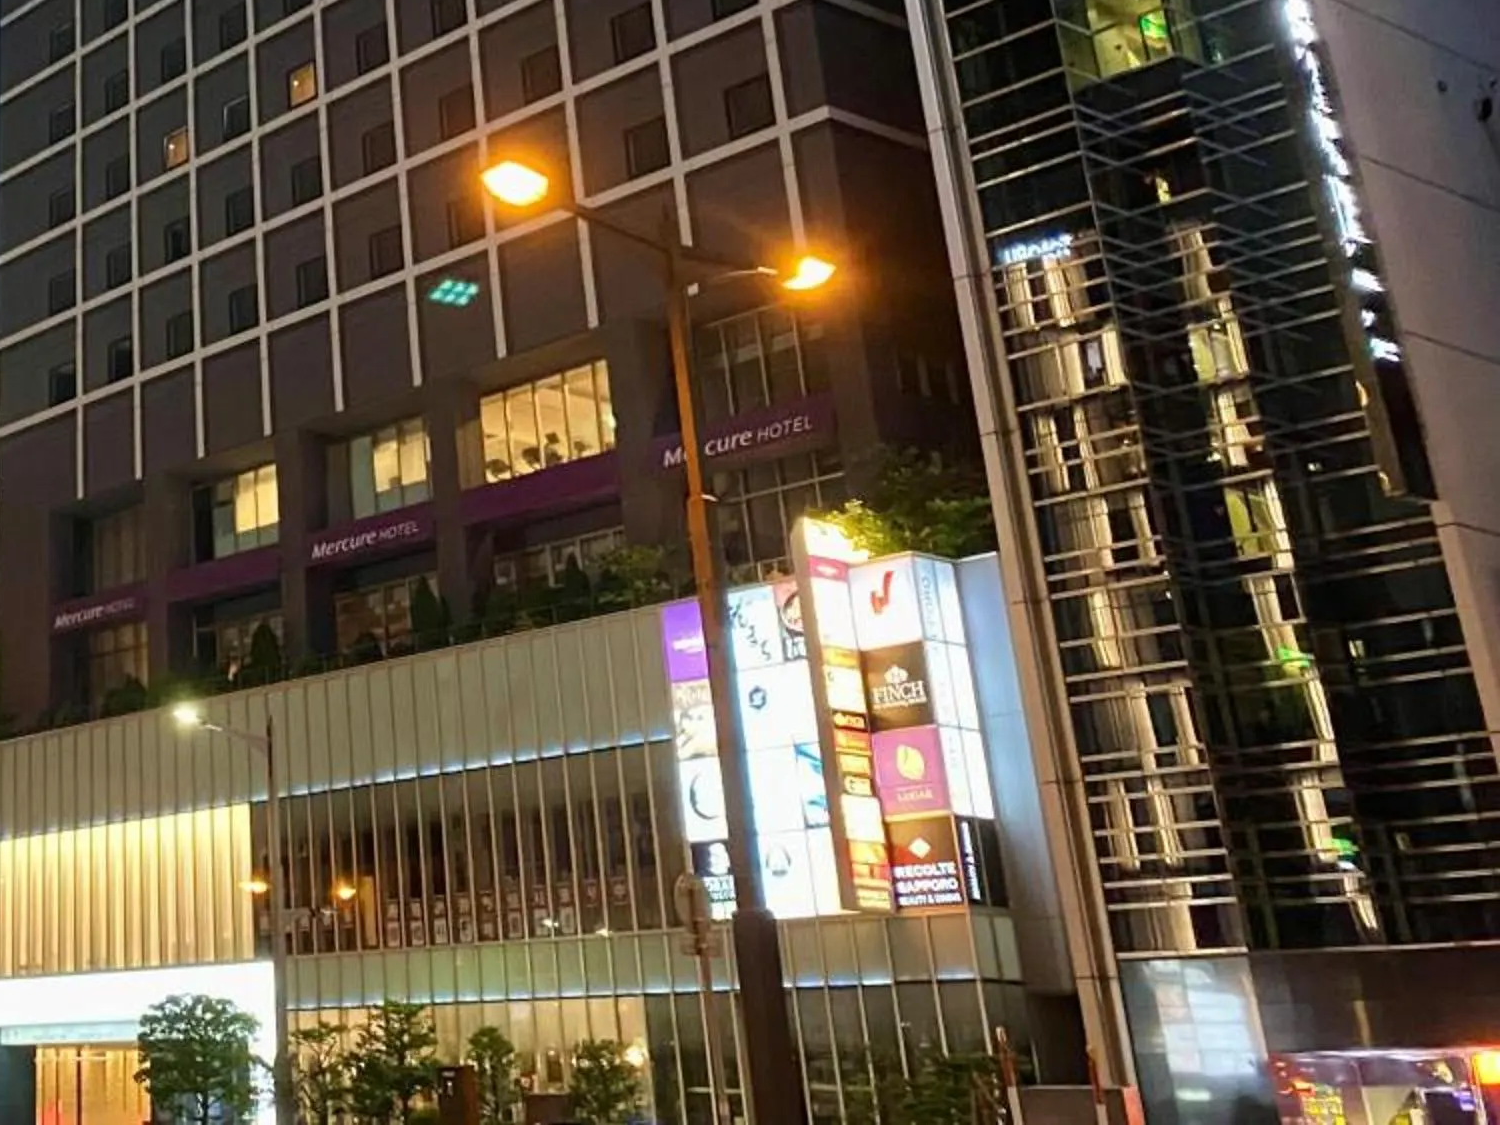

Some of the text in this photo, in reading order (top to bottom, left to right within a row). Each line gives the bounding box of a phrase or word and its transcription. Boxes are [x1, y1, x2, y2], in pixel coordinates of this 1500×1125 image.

[663, 415, 813, 468] Mcure HOTEL
[311, 521, 419, 560] Mercure HOTEL
[872, 679, 926, 704] FINCH
